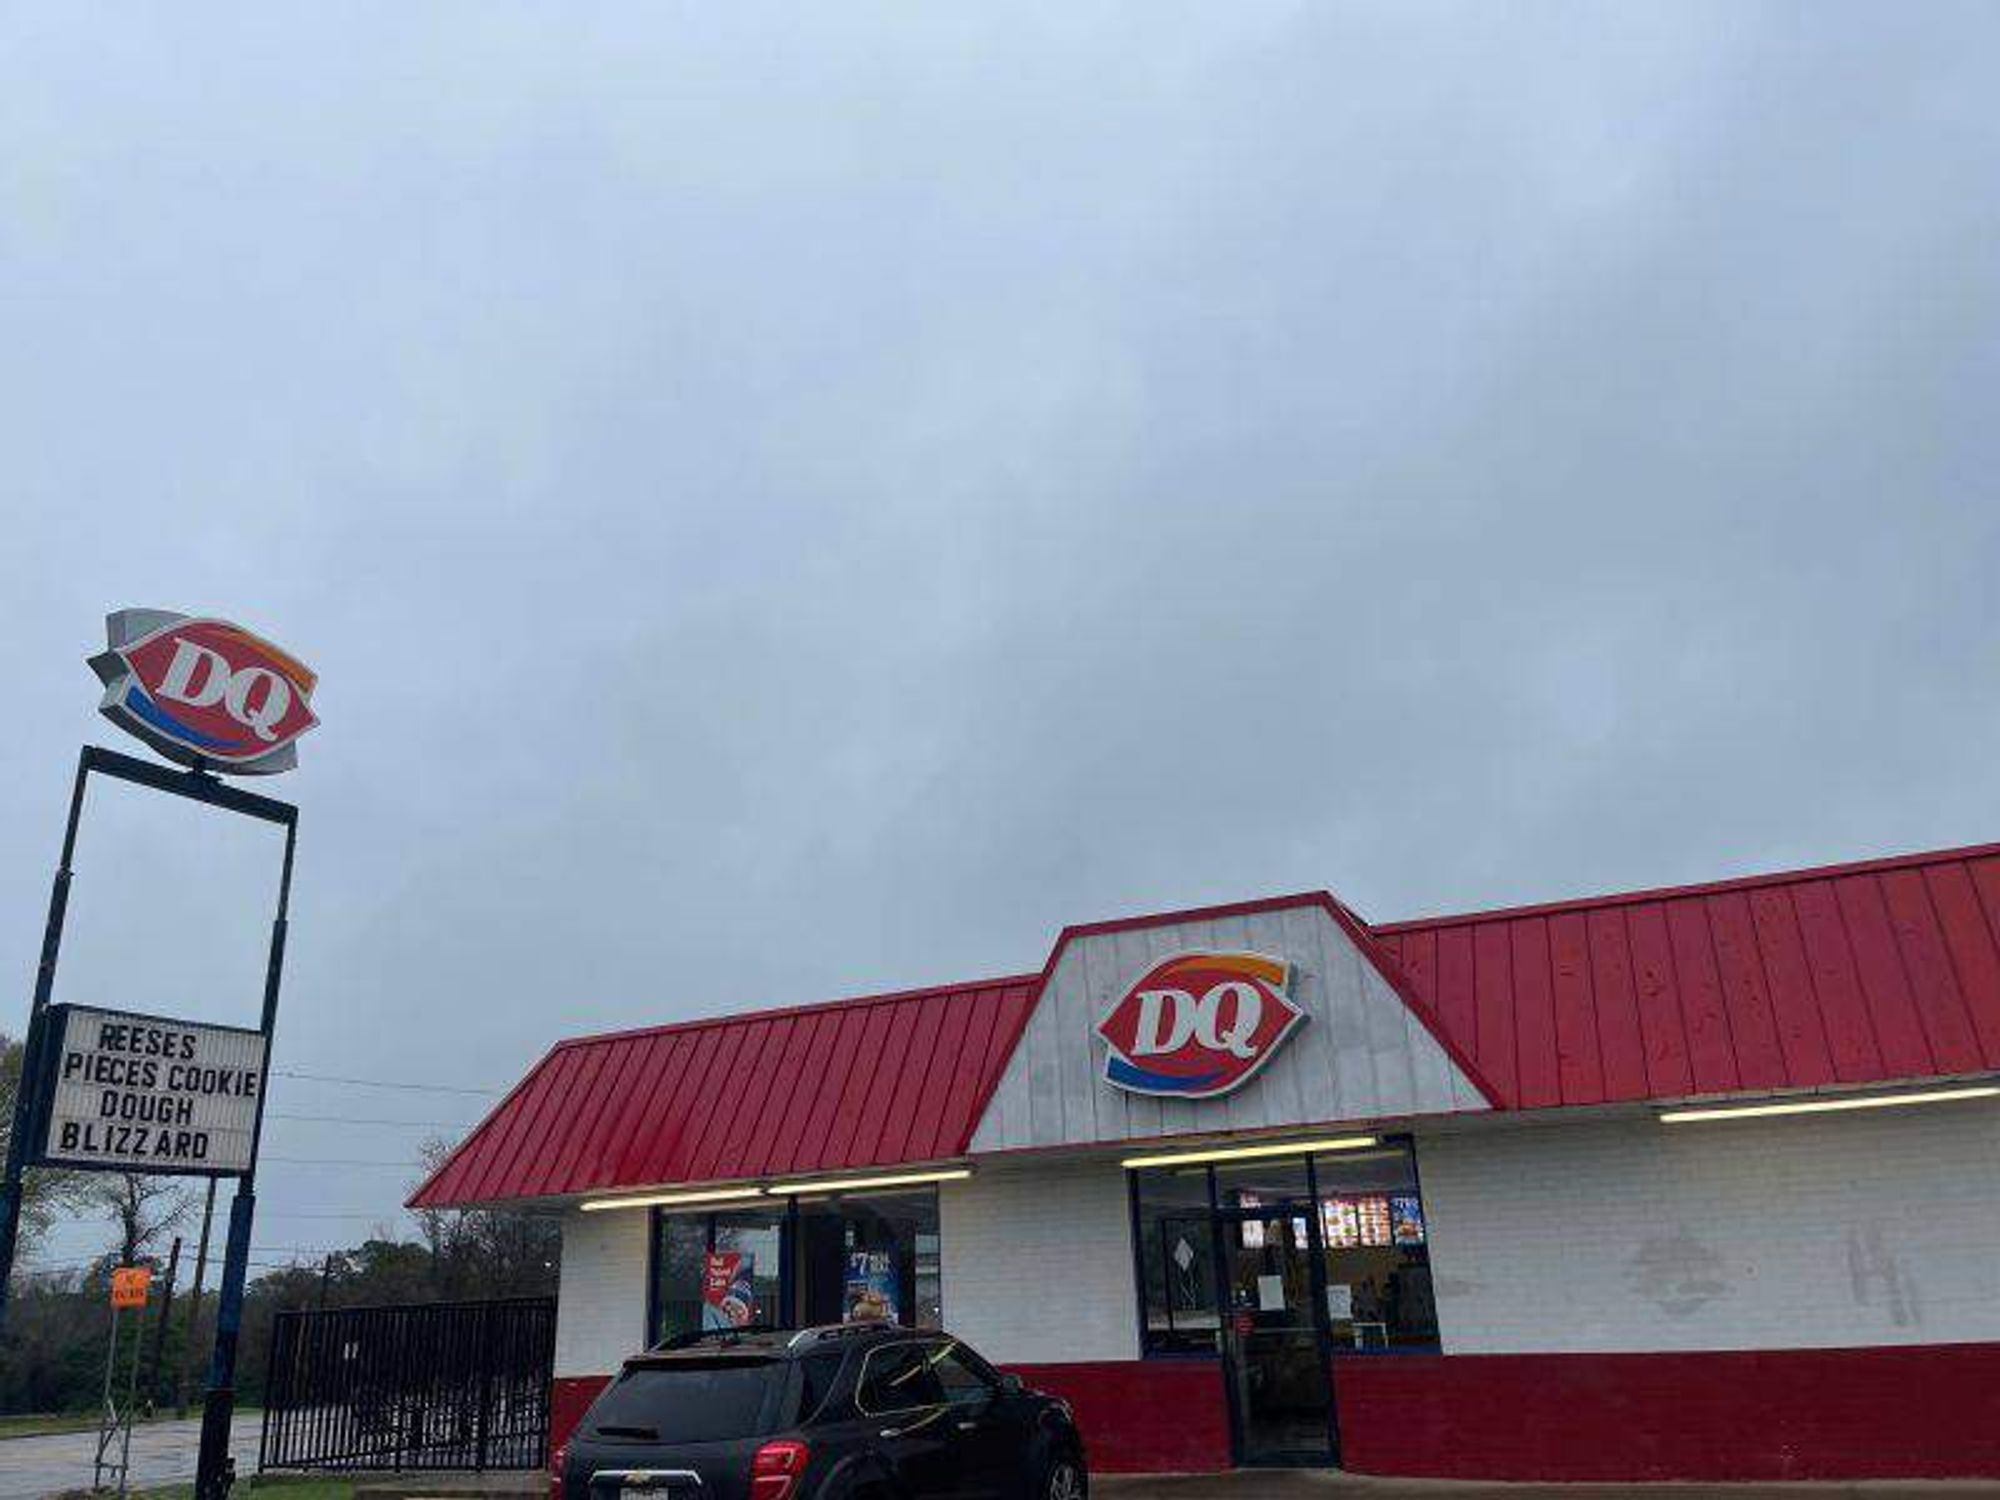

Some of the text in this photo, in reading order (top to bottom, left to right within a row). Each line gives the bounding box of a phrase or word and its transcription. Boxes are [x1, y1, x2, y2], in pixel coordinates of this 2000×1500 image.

[155, 637, 291, 742] DQ
[98, 1022, 196, 1060] REESES
[1130, 981, 1263, 1059] DQ
[63, 1051, 258, 1097] PIECES COOKIE
[100, 1089, 194, 1125] DOUGH
[60, 1122, 209, 1159] BLIZZARD
